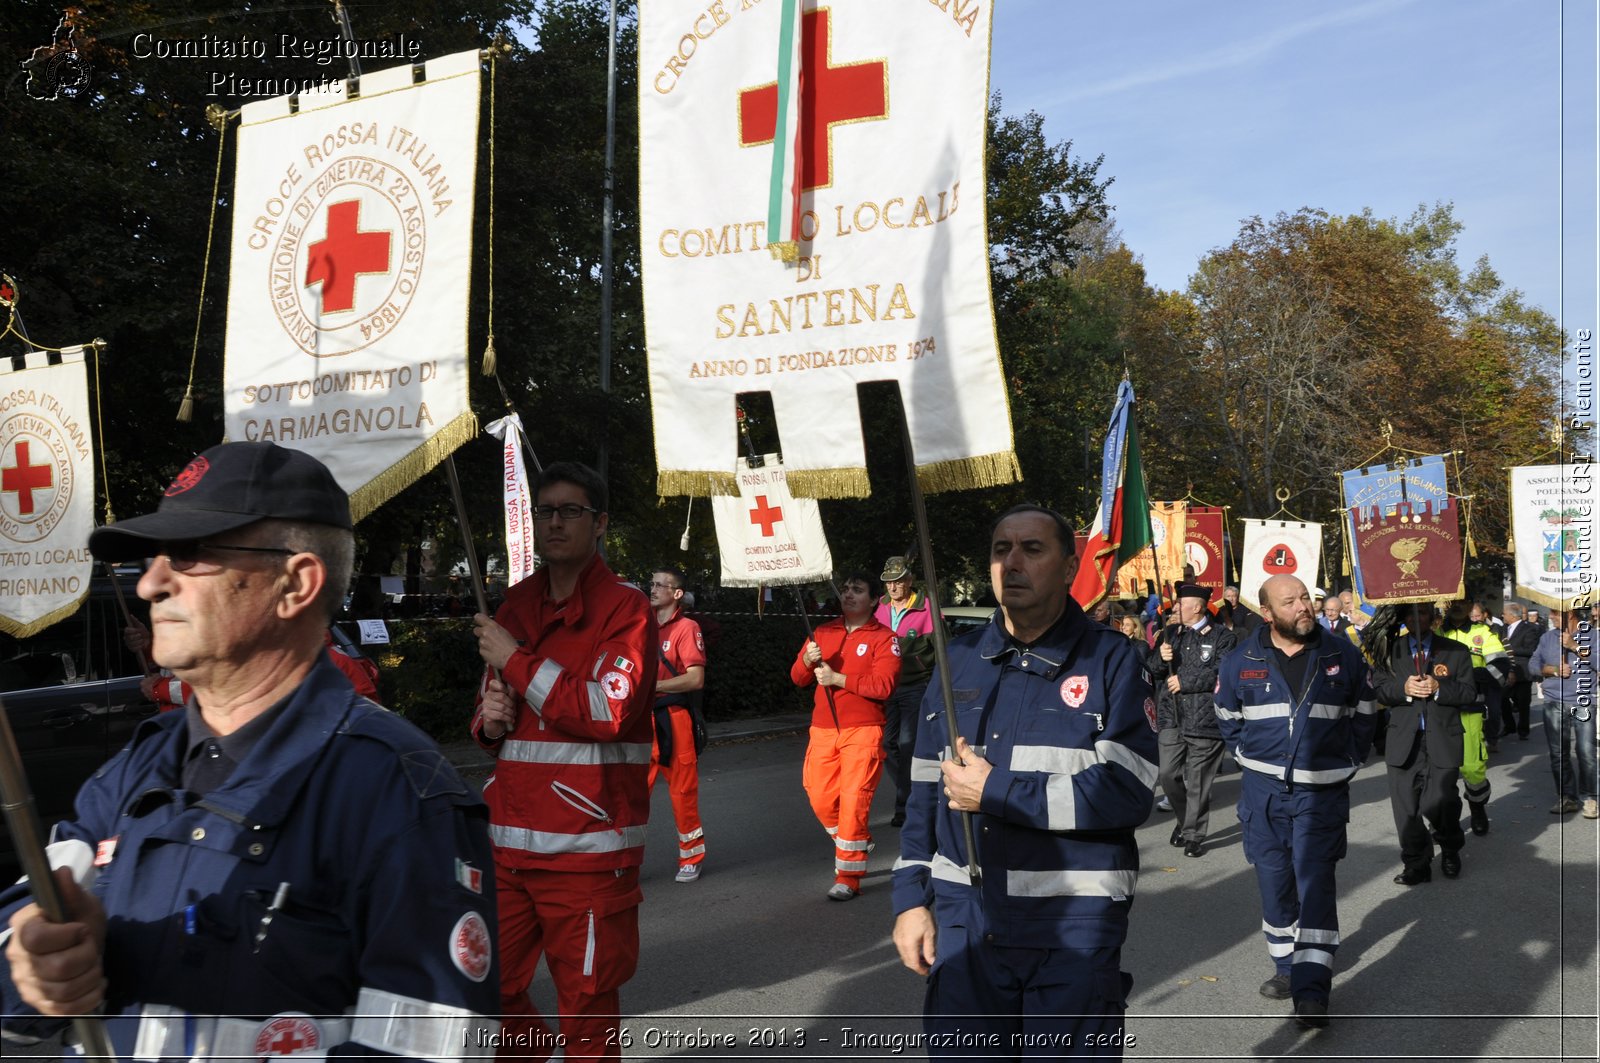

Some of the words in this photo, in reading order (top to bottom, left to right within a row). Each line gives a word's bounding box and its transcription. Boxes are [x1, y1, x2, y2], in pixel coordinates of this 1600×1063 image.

[654, 0, 732, 94] CROCE
[248, 162, 302, 250] CROCE
[303, 122, 378, 168] ROSSA
[386, 125, 454, 218] ITALIANA
[316, 160, 386, 198] GINEVRA
[387, 177, 410, 204] 22
[294, 195, 315, 220] DI
[658, 210, 820, 259] COMITO
[836, 180, 961, 236] LOCALE
[399, 205, 423, 296] AGOSTO
[795, 254, 822, 283] DI
[273, 223, 319, 350] CONVENZIONE
[360, 301, 401, 341] 1864
[715, 282, 917, 339] SANTENA
[689, 360, 748, 378] ANNO
[754, 357, 772, 375] DI
[777, 344, 897, 372] FONDAZIONE
[905, 336, 936, 361] 1974
[244, 366, 413, 404] SOTTOCOMITATO
[419, 360, 438, 383] DI
[8, 417, 53, 440] GINEVRA
[40, 392, 89, 461] ITALIANA
[245, 402, 434, 443] CARMAGNOLA
[56, 459, 70, 509] AGOSTO
[505, 442, 516, 493] ITALIANA
[1388, 473, 1443, 496] NIHELINO
[1530, 498, 1550, 506] NEL
[1558, 498, 1595, 506] MONDO
[1536, 488, 1582, 496] POLESAN
[36, 511, 59, 535] 1864
[508, 497, 520, 535] ROSSA
[35, 548, 90, 565] LOCALE
[745, 545, 773, 556] COMITATO
[774, 542, 798, 553] LOCALE
[747, 556, 802, 572] BORGOSESIA
